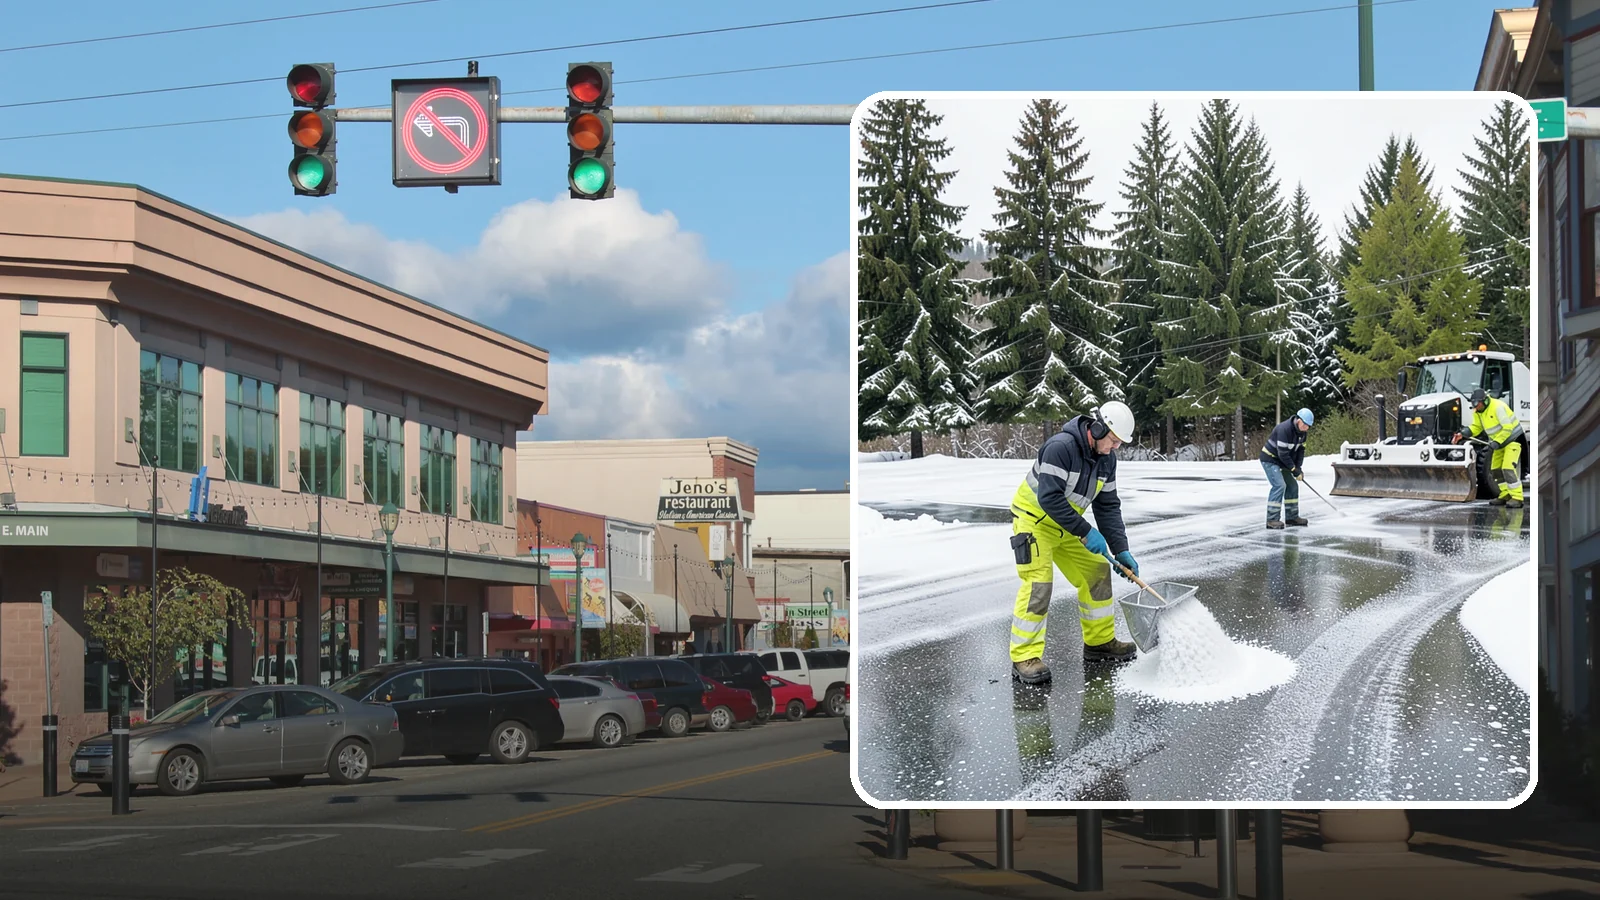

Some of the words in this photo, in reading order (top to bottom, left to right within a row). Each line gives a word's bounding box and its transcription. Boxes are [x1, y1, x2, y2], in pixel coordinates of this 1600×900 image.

[670, 480, 727, 494] Jeno's
[665, 496, 730, 508] restaurant
[658, 510, 681, 519] Italian
[686, 509, 714, 519] American
[715, 510, 737, 518] Cuisine
[2, 525, 13, 536] E.
[15, 525, 49, 536] MAIN
[797, 607, 828, 617] Street
